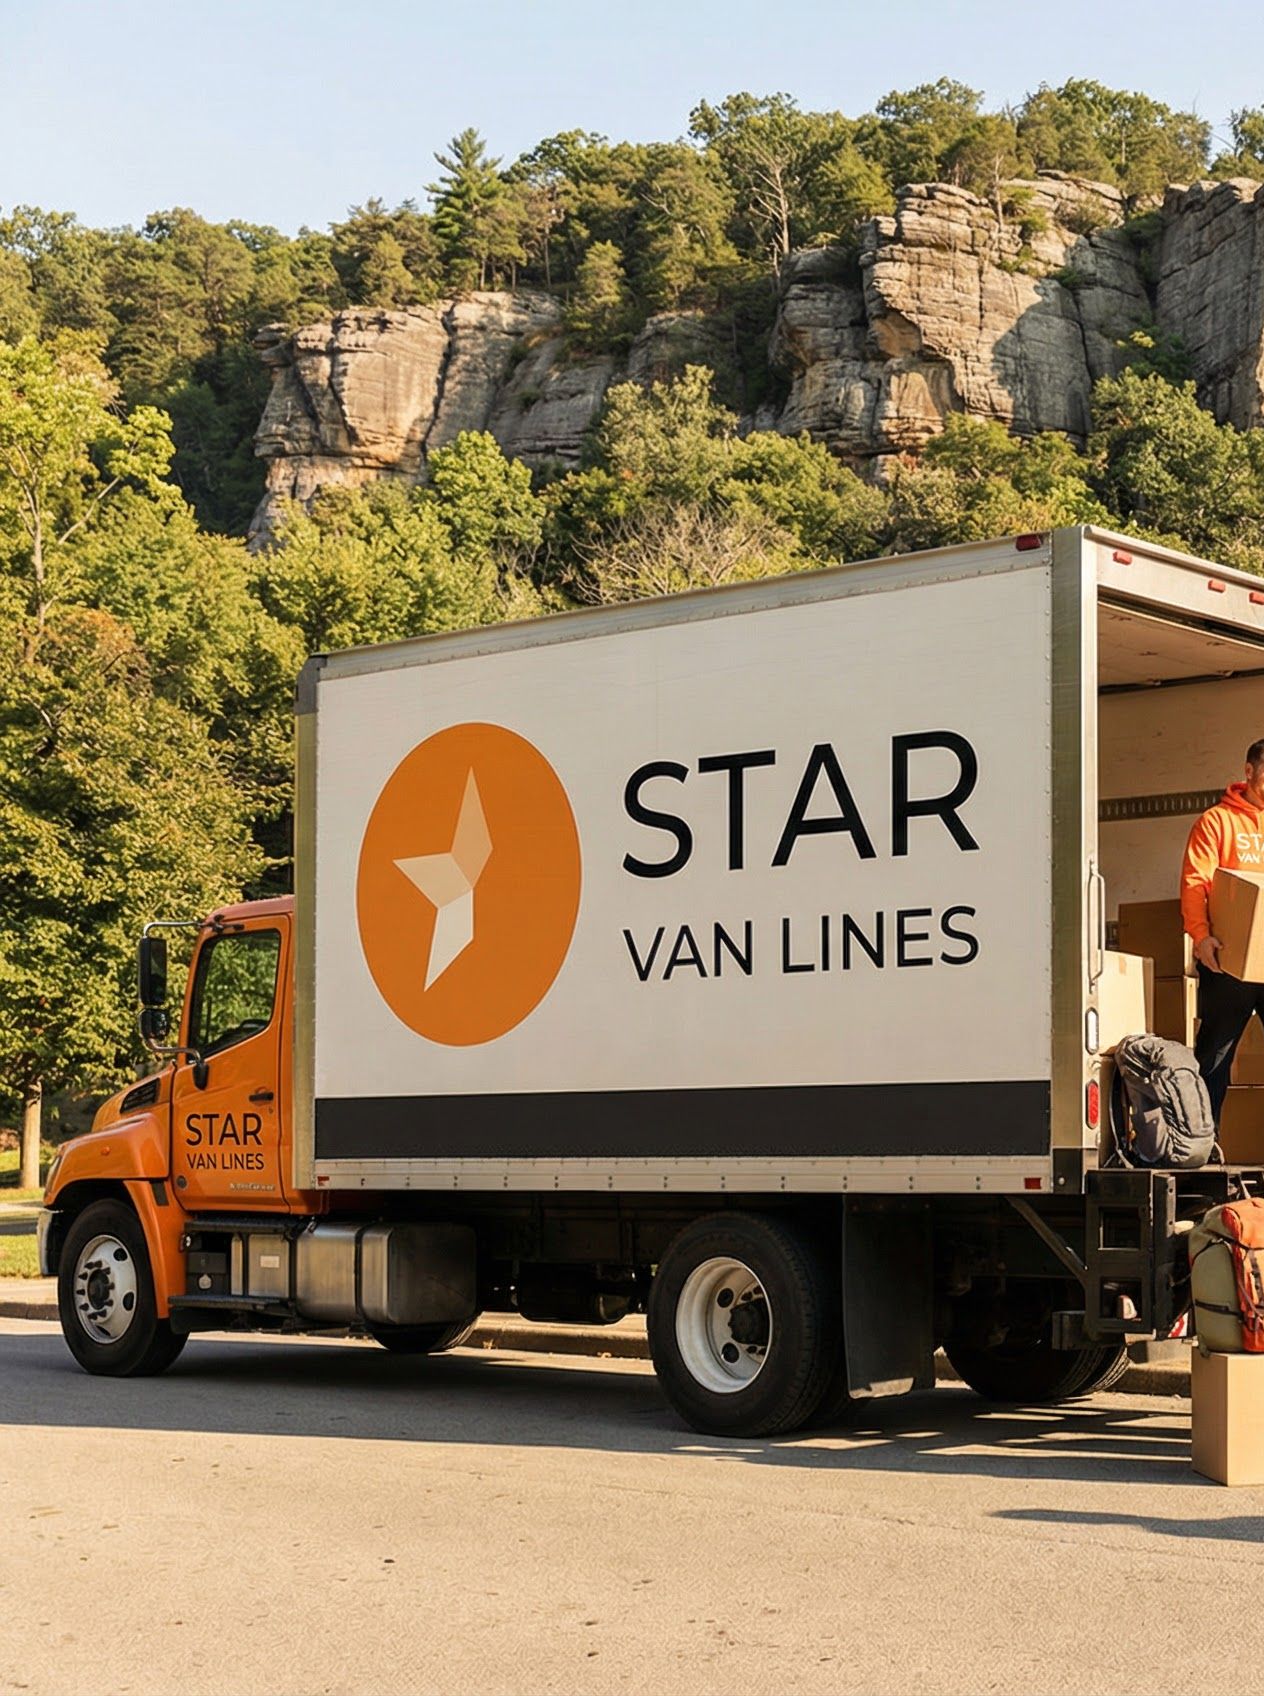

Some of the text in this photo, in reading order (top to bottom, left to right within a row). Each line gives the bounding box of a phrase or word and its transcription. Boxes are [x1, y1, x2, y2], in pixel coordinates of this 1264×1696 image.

[622, 729, 980, 879] STAR
[1237, 853, 1260, 864] VAN
[622, 905, 980, 982] VAN LINES
[186, 1113, 262, 1146] STAR
[186, 1153, 264, 1170] VAN LINES
